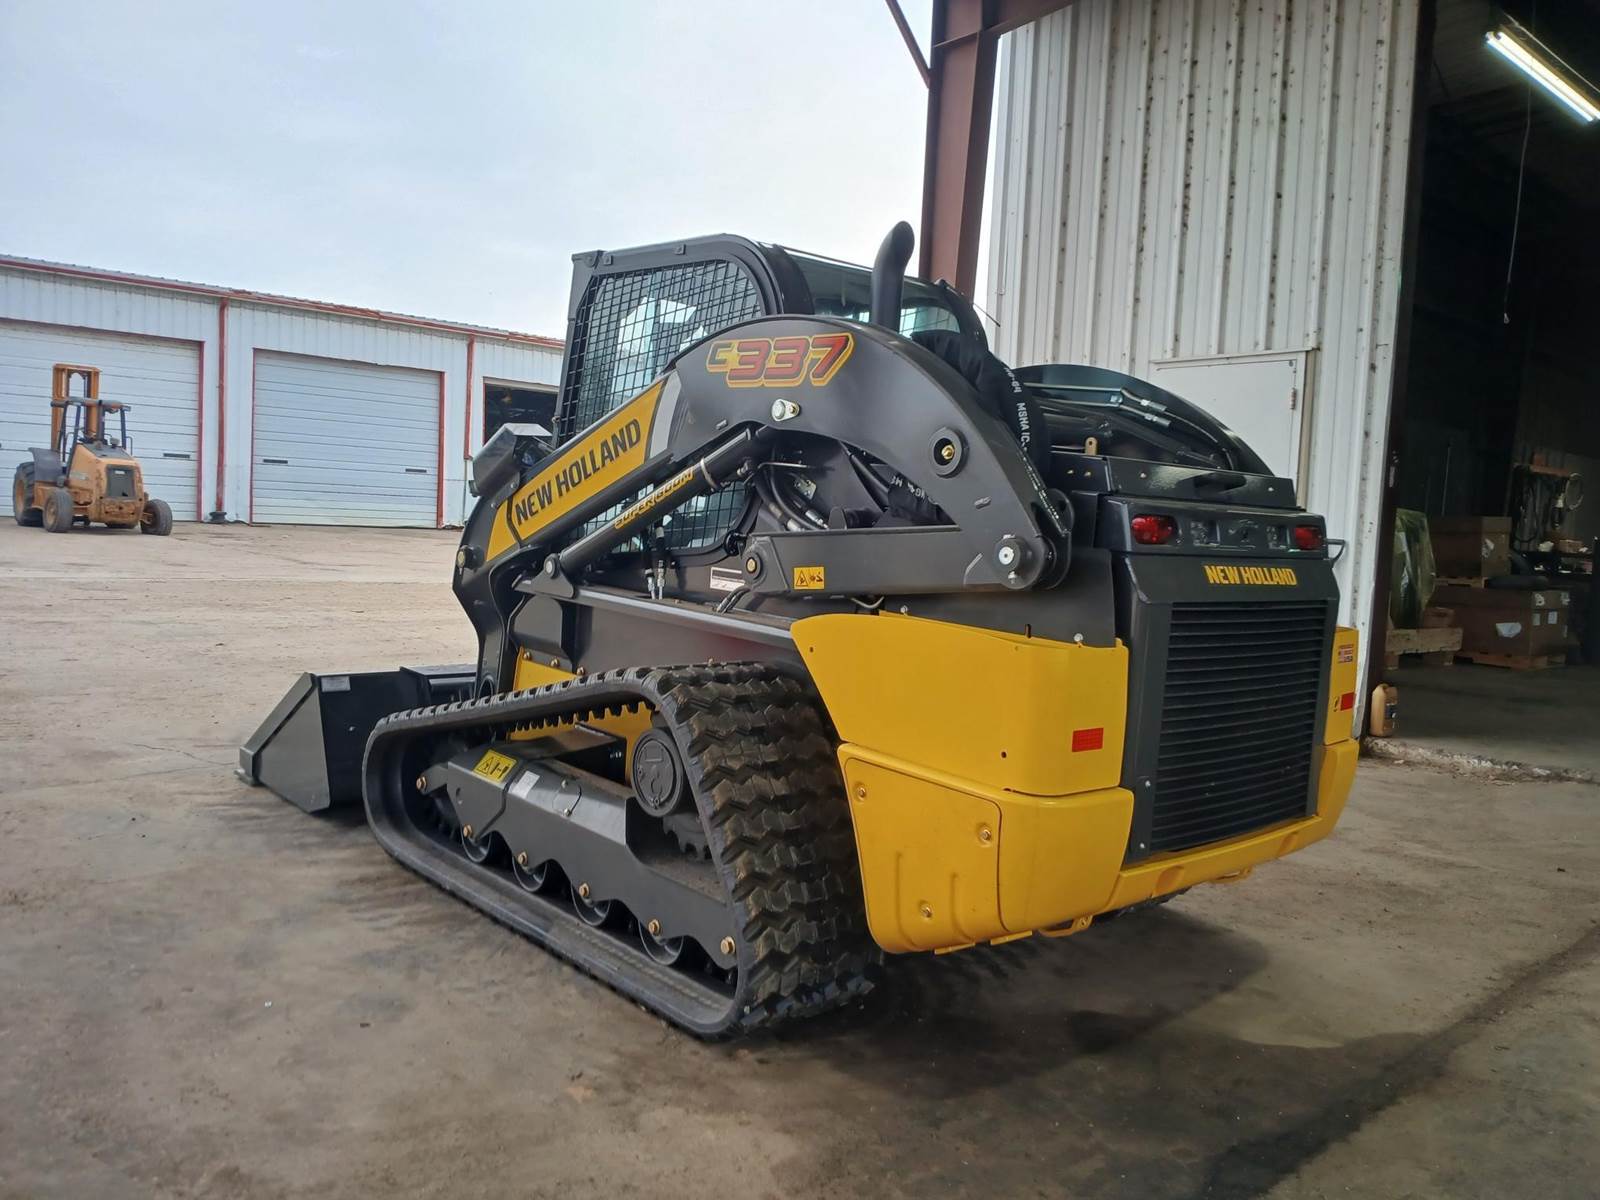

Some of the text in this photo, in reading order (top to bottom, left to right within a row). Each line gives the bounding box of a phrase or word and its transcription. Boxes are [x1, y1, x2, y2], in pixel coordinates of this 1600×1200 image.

[706, 332, 855, 388] C337
[1016, 402, 1030, 430] MSHA
[514, 417, 642, 526] NEW HOLLAND
[1204, 565, 1298, 586] NEW HOLLAND
